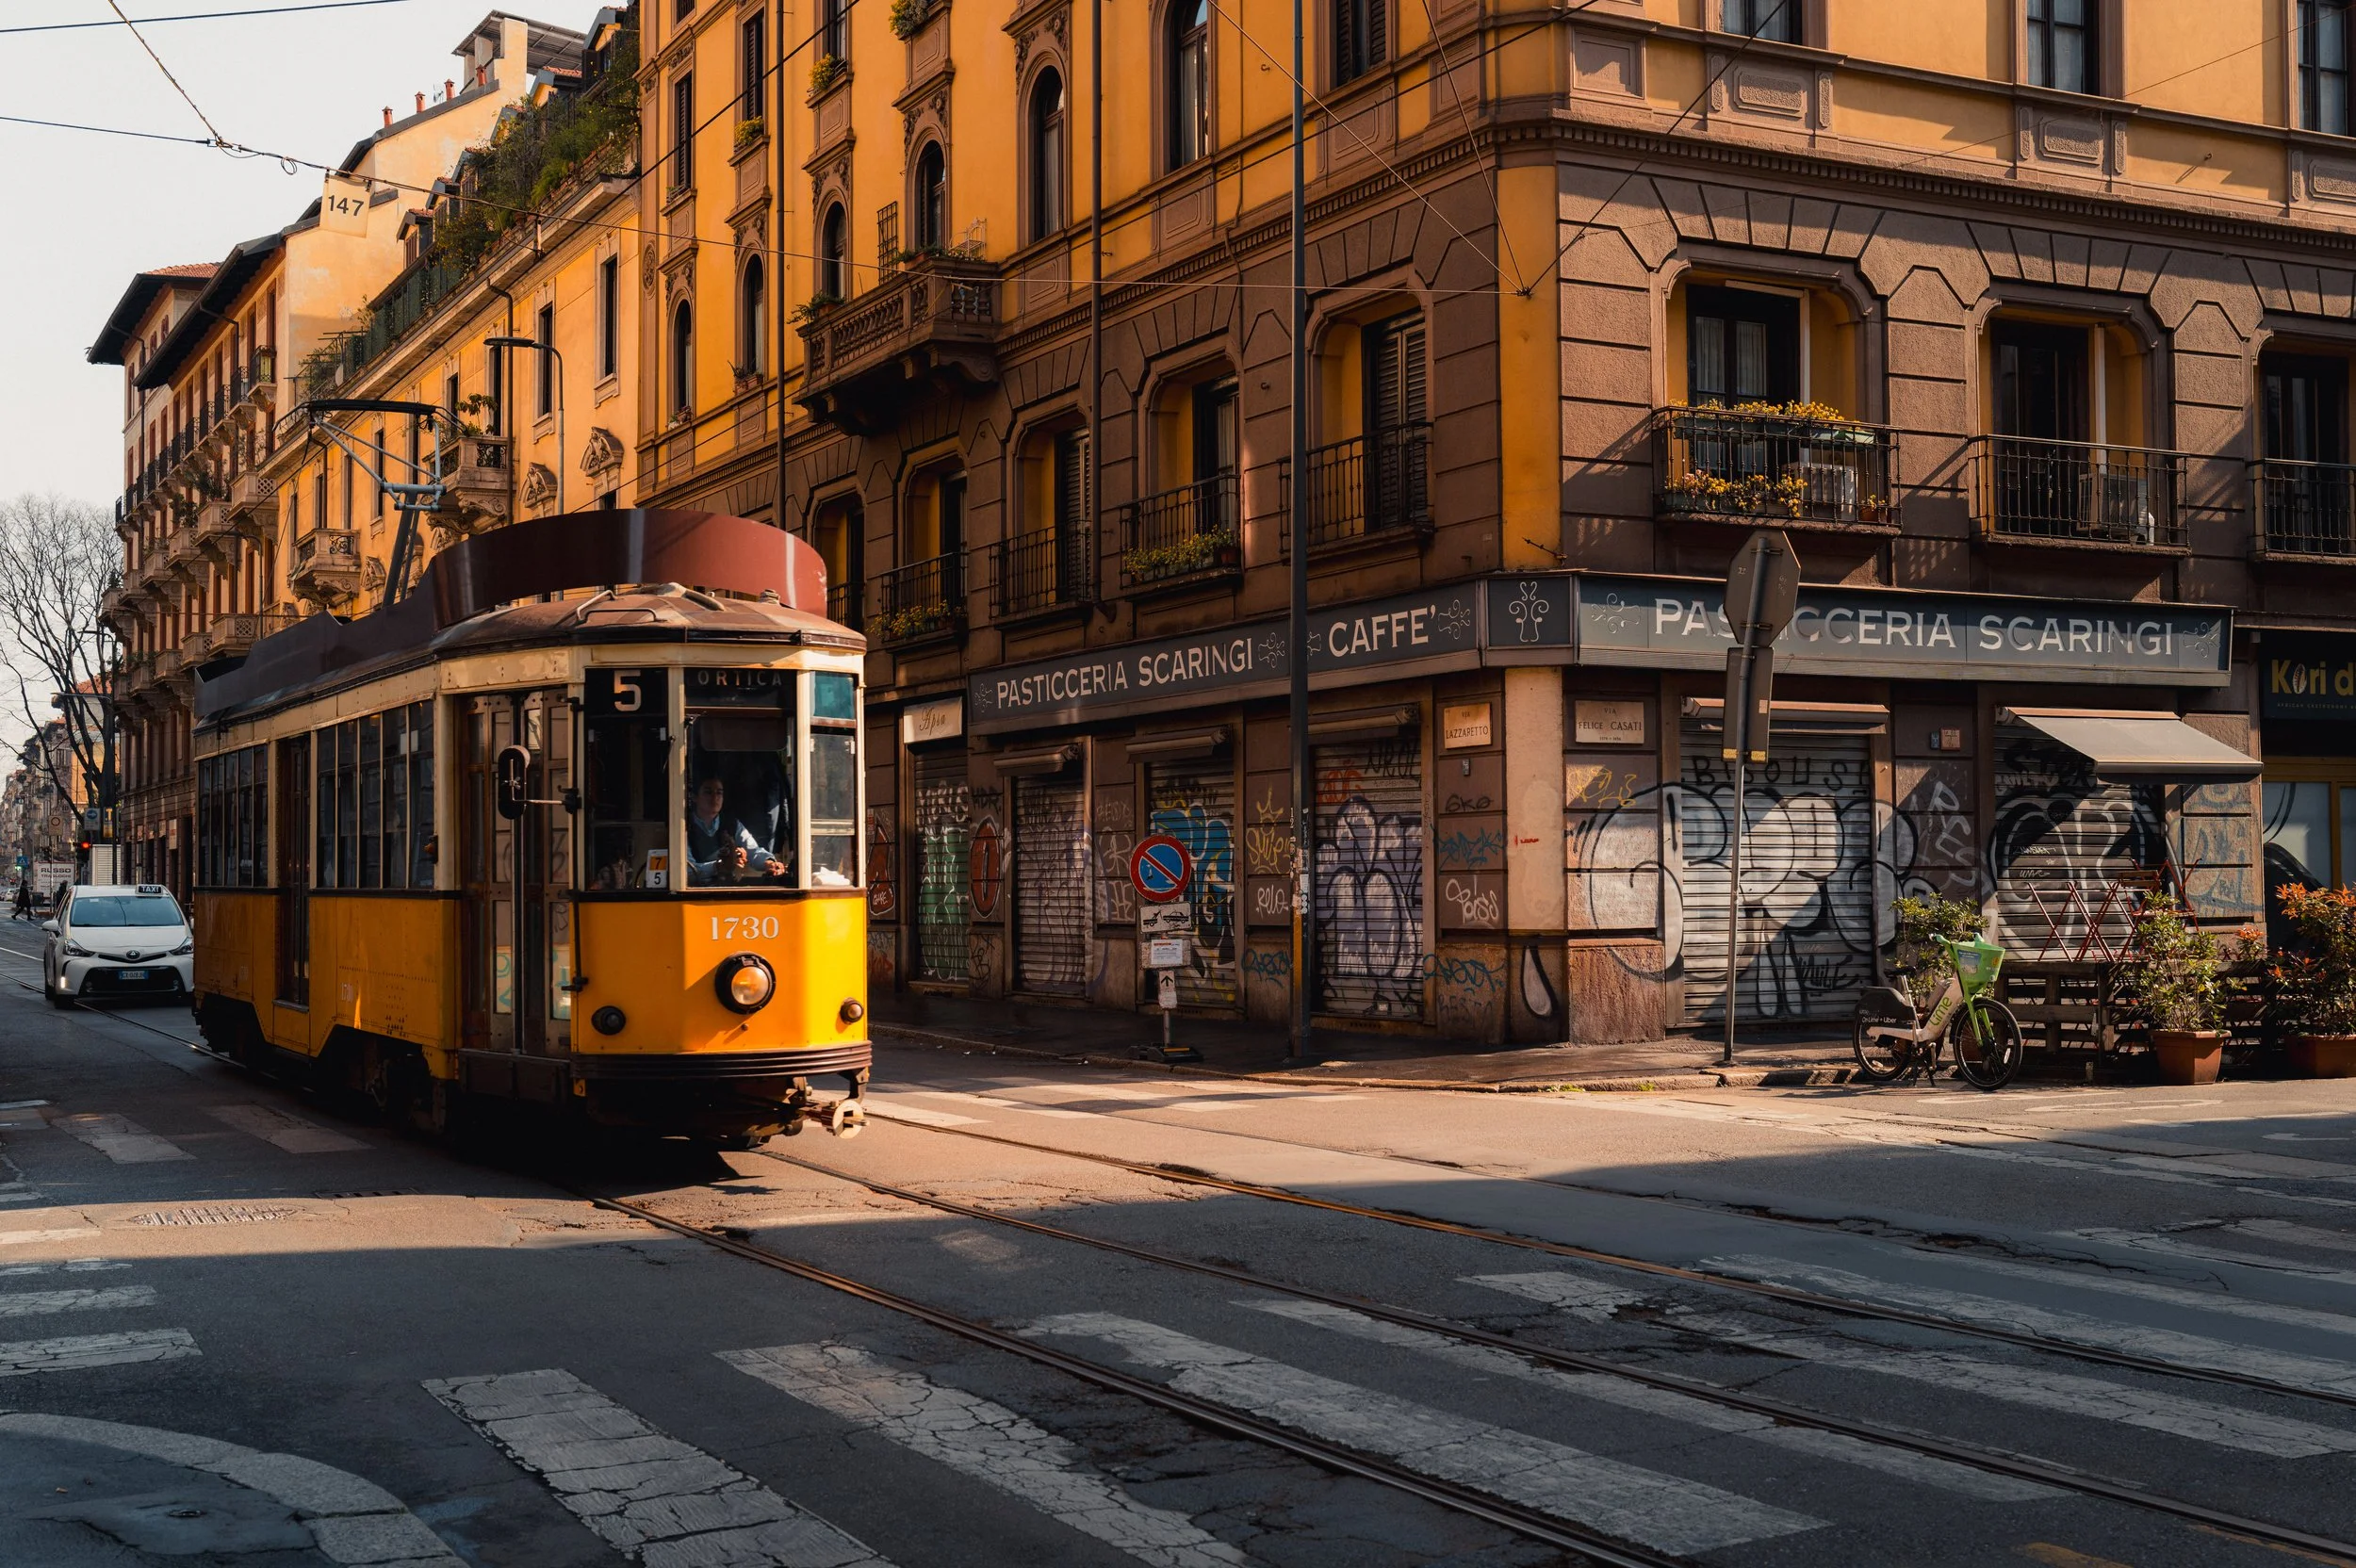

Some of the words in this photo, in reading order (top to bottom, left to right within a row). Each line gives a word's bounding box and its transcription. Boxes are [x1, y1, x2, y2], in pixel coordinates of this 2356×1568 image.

[328, 194, 365, 217] 147
[1655, 597, 1956, 648] PASCCERIA
[1979, 614, 2173, 655] SCARINGI
[997, 661, 1128, 709] PASTICCERIA
[1138, 637, 1252, 687] SCARINGI
[1329, 604, 1436, 658] CAFFE'
[697, 670, 782, 686] ORTICA
[614, 670, 642, 711] 5
[1446, 726, 1489, 740] LAZZARETTO
[1579, 721, 1604, 729] FELICE
[1611, 721, 1643, 731] CASATI
[654, 857, 663, 870] 7
[654, 872, 662, 885] 5
[141, 886, 159, 894] TAXI
[712, 916, 779, 940] 1730
